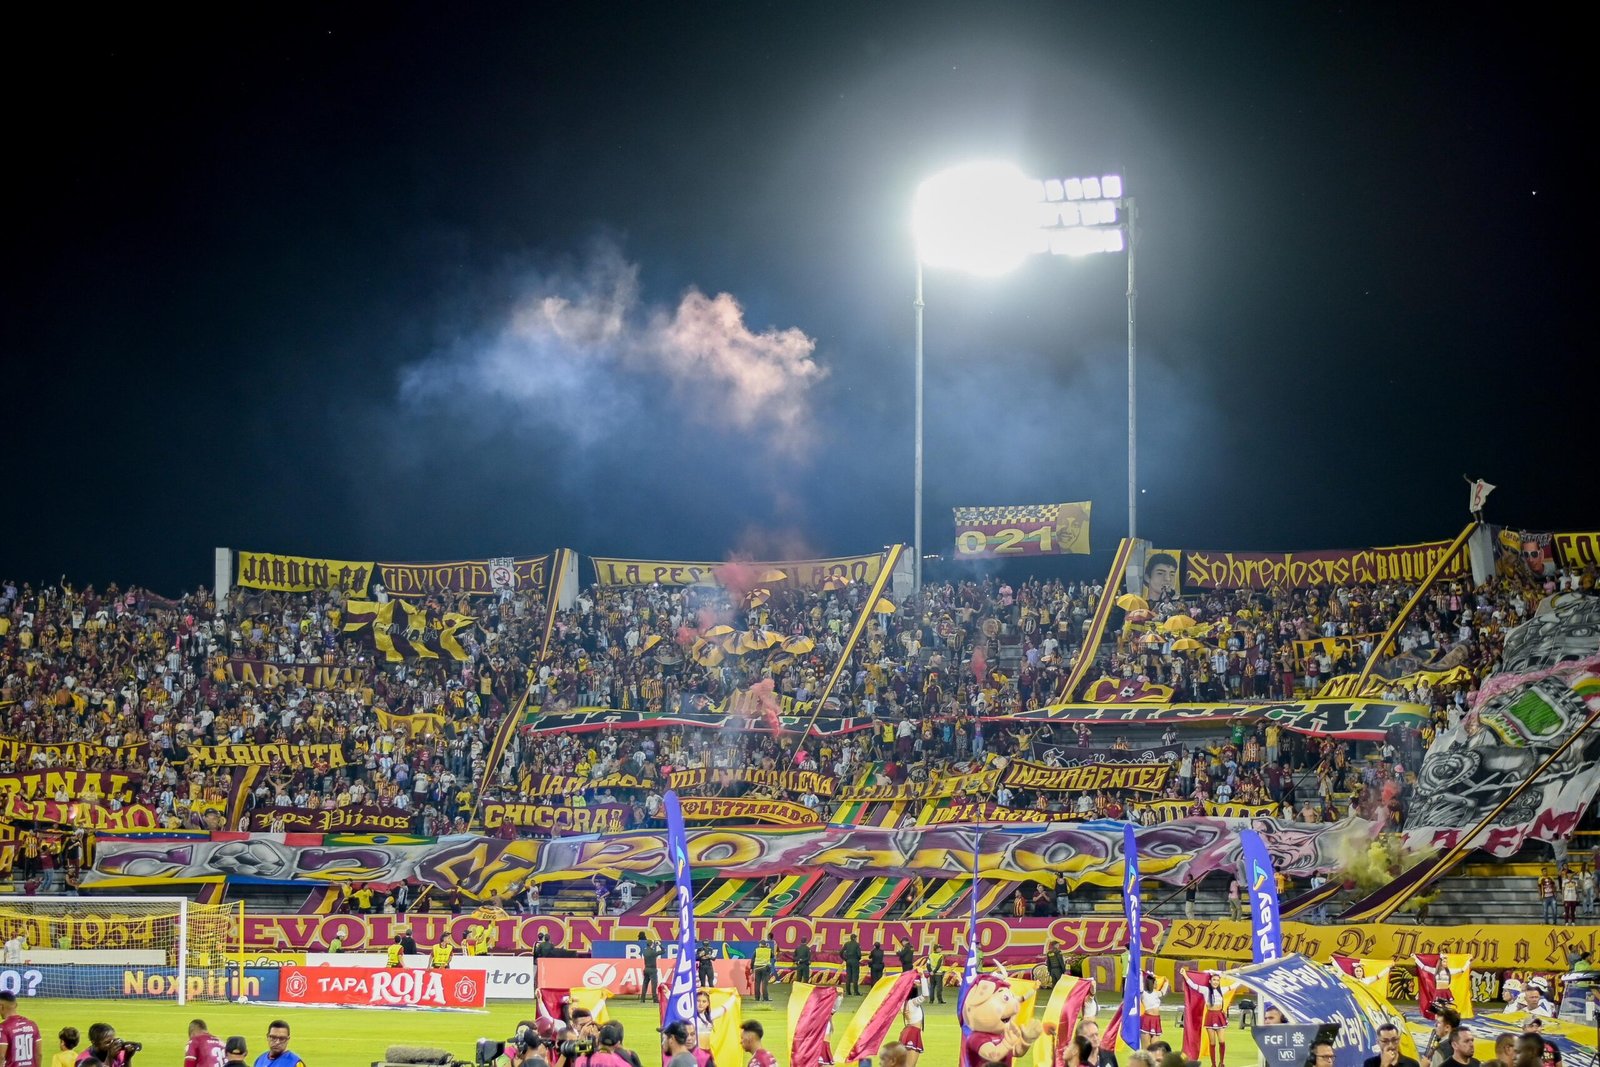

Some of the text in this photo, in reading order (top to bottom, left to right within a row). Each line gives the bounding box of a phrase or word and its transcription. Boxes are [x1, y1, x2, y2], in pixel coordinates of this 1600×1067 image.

[381, 567, 487, 592] GAVIOTA
[1187, 551, 1350, 587] Sobredosis
[1004, 763, 1169, 791] INSURGENTES
[317, 811, 410, 831] Pijaos
[485, 804, 623, 833] CHICORA
[1051, 919, 1164, 953] SUR
[1331, 927, 1377, 957] De
[123, 970, 259, 999] Noxpirin
[318, 970, 446, 1005] TAPA ROJA
[486, 968, 531, 985] tro
[15, 1033, 33, 1062] 80
[1264, 1035, 1283, 1045] FCF
[1279, 1050, 1294, 1059] VAR
